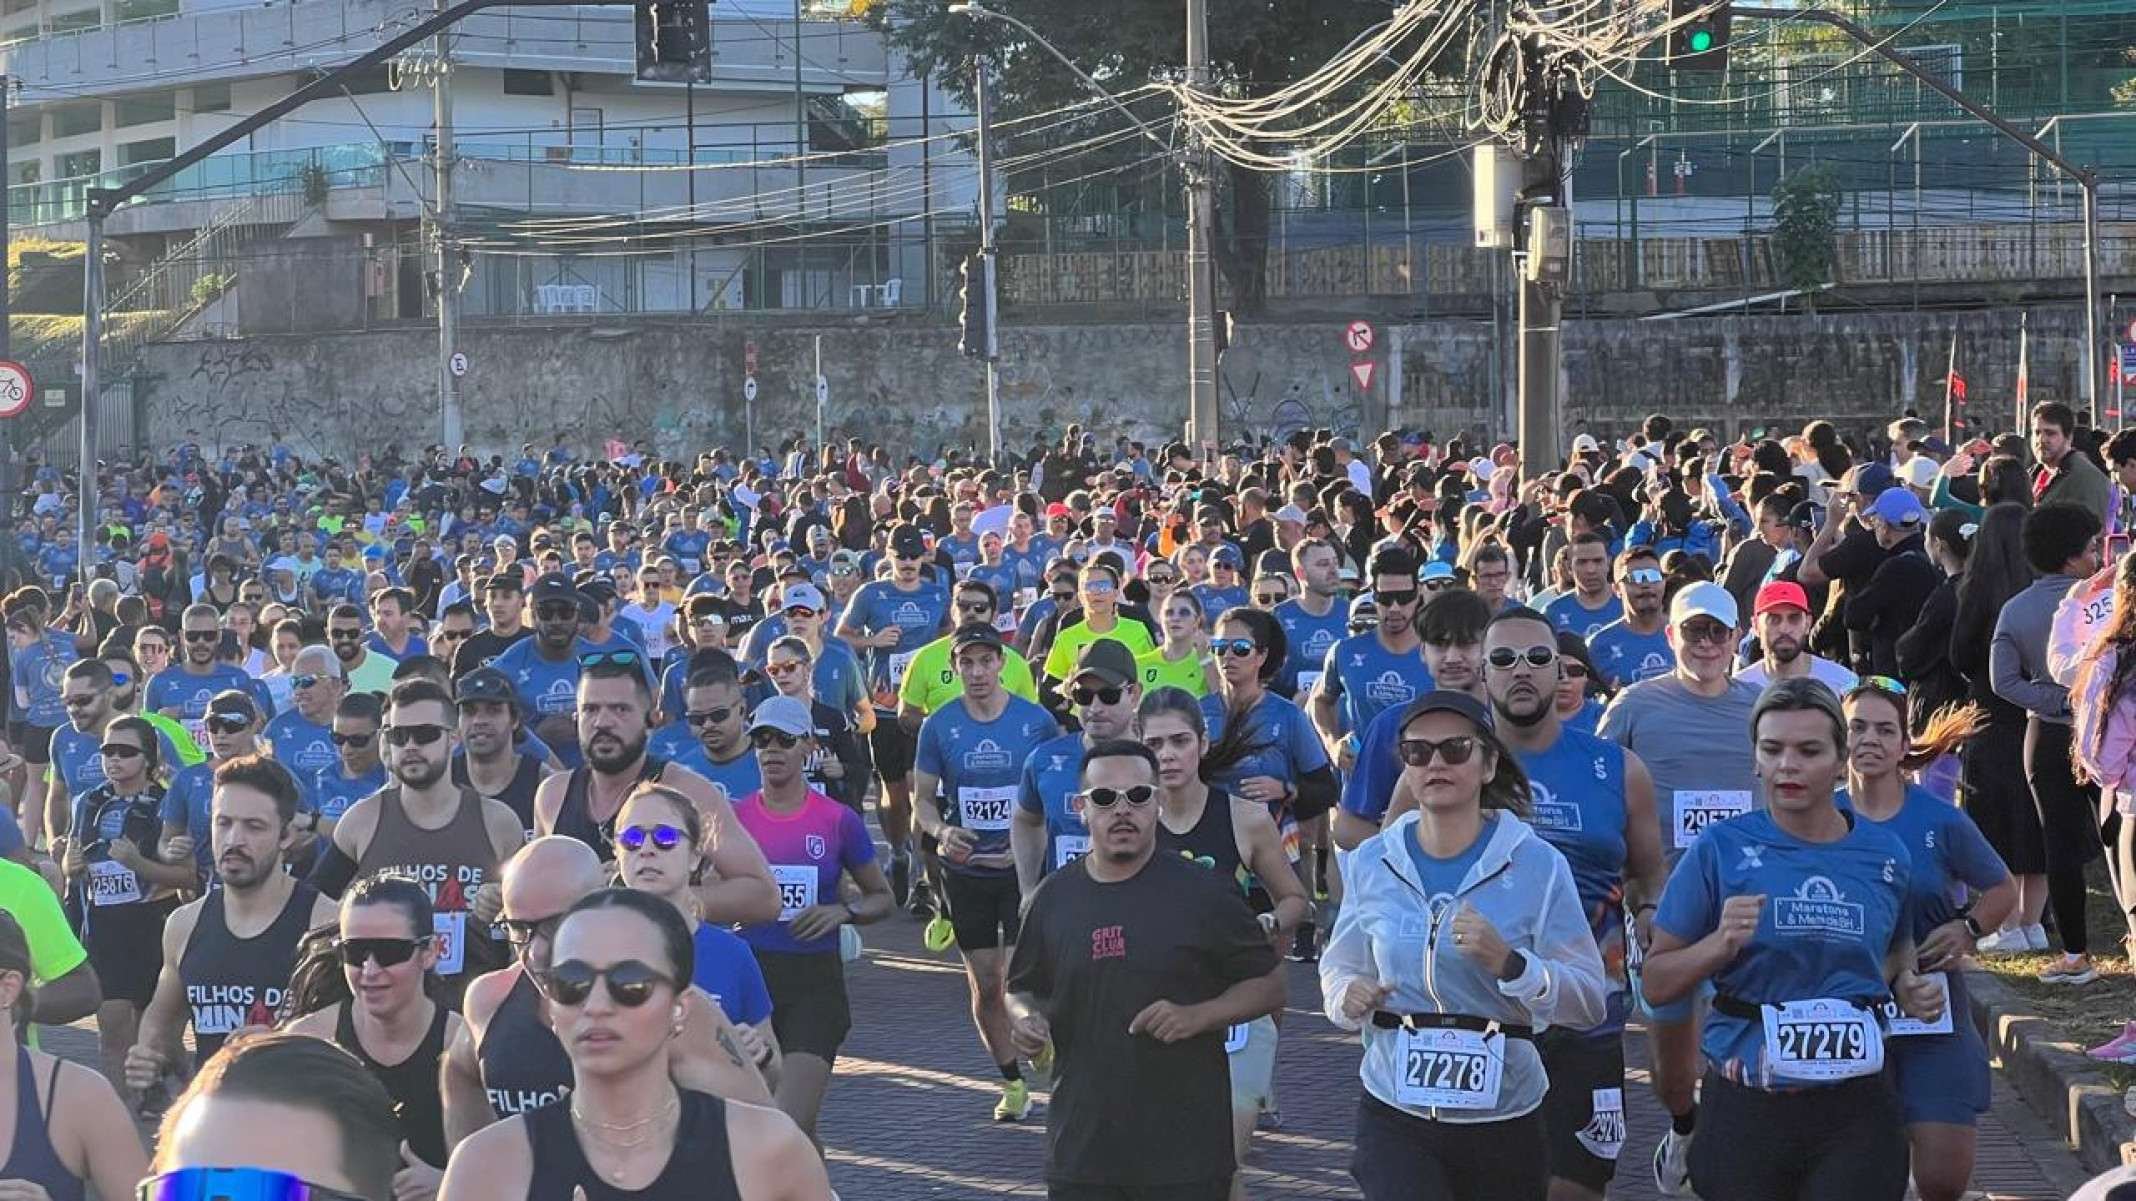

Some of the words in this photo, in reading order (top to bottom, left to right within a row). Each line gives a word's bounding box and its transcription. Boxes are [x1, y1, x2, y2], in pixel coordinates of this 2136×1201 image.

[458, 865, 482, 883] DE
[187, 985, 256, 1005] FILHOS
[1779, 1023, 1866, 1060] 27279
[1406, 1050, 1485, 1092] 27278
